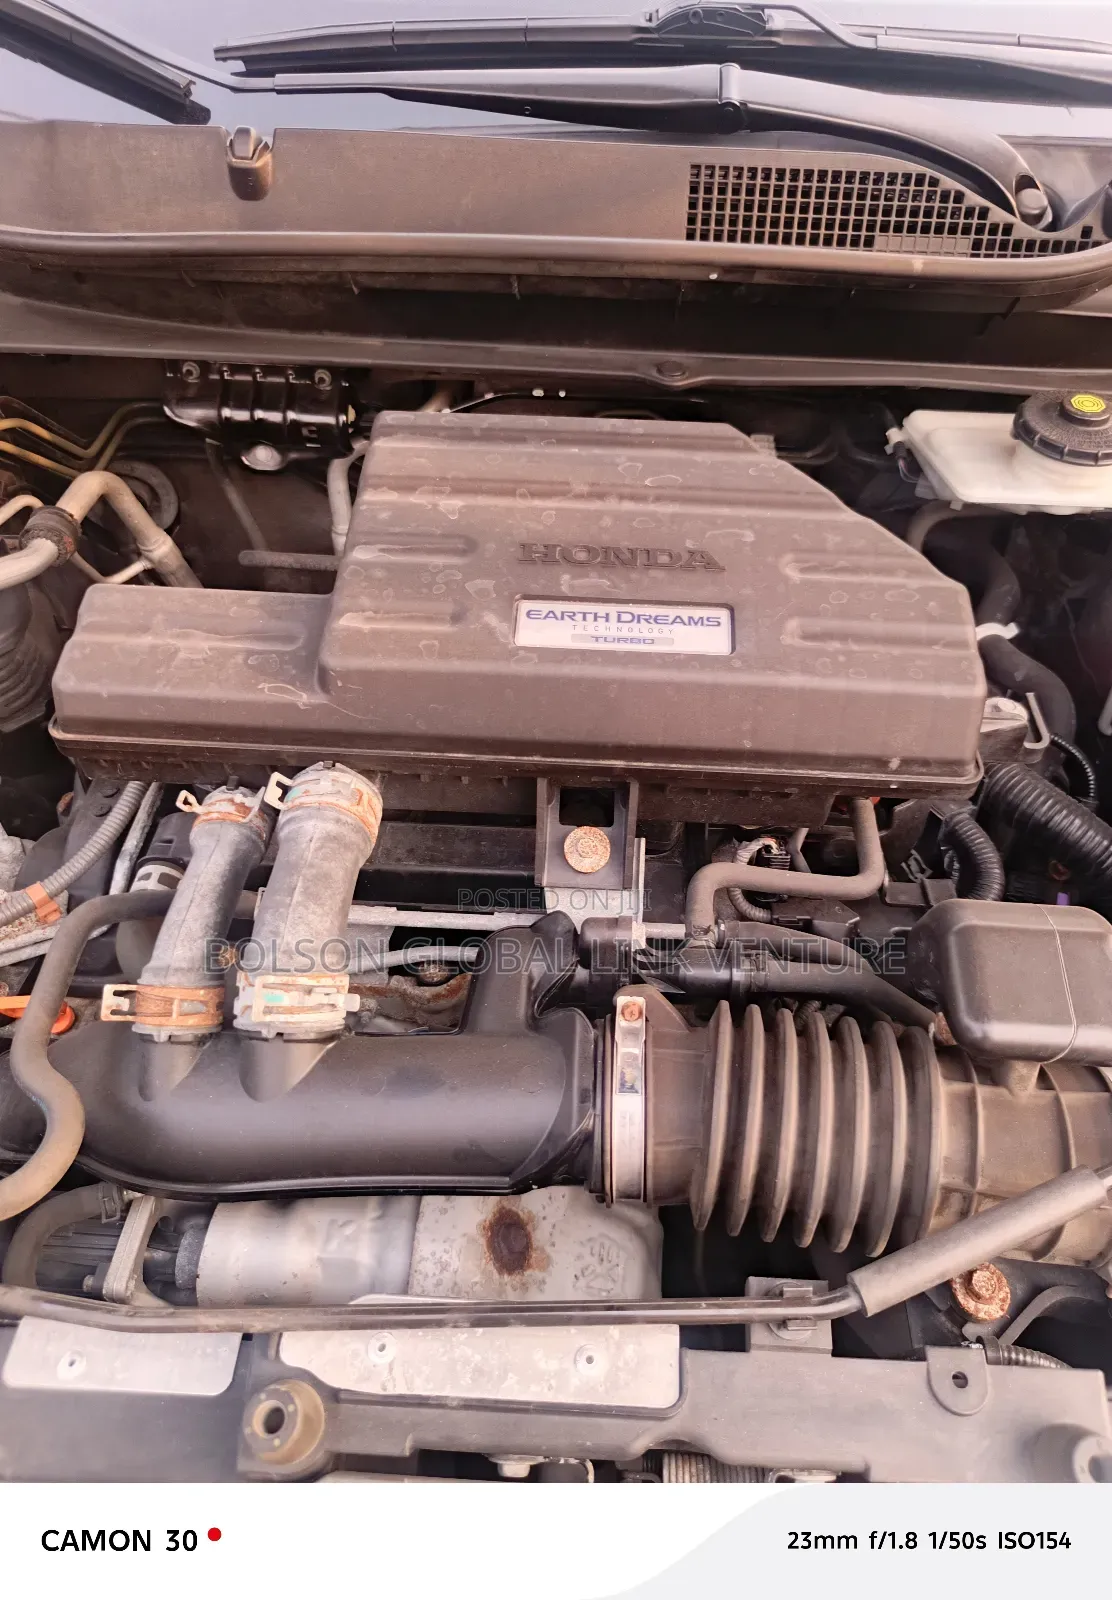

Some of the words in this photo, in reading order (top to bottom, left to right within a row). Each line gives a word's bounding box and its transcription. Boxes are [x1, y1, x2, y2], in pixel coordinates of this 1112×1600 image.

[518, 542, 726, 571] HONDA
[526, 609, 610, 624] EARTH
[616, 611, 722, 628] DREAMS
[572, 624, 674, 636] TECHNOLOGY
[590, 635, 655, 646] TURBO
